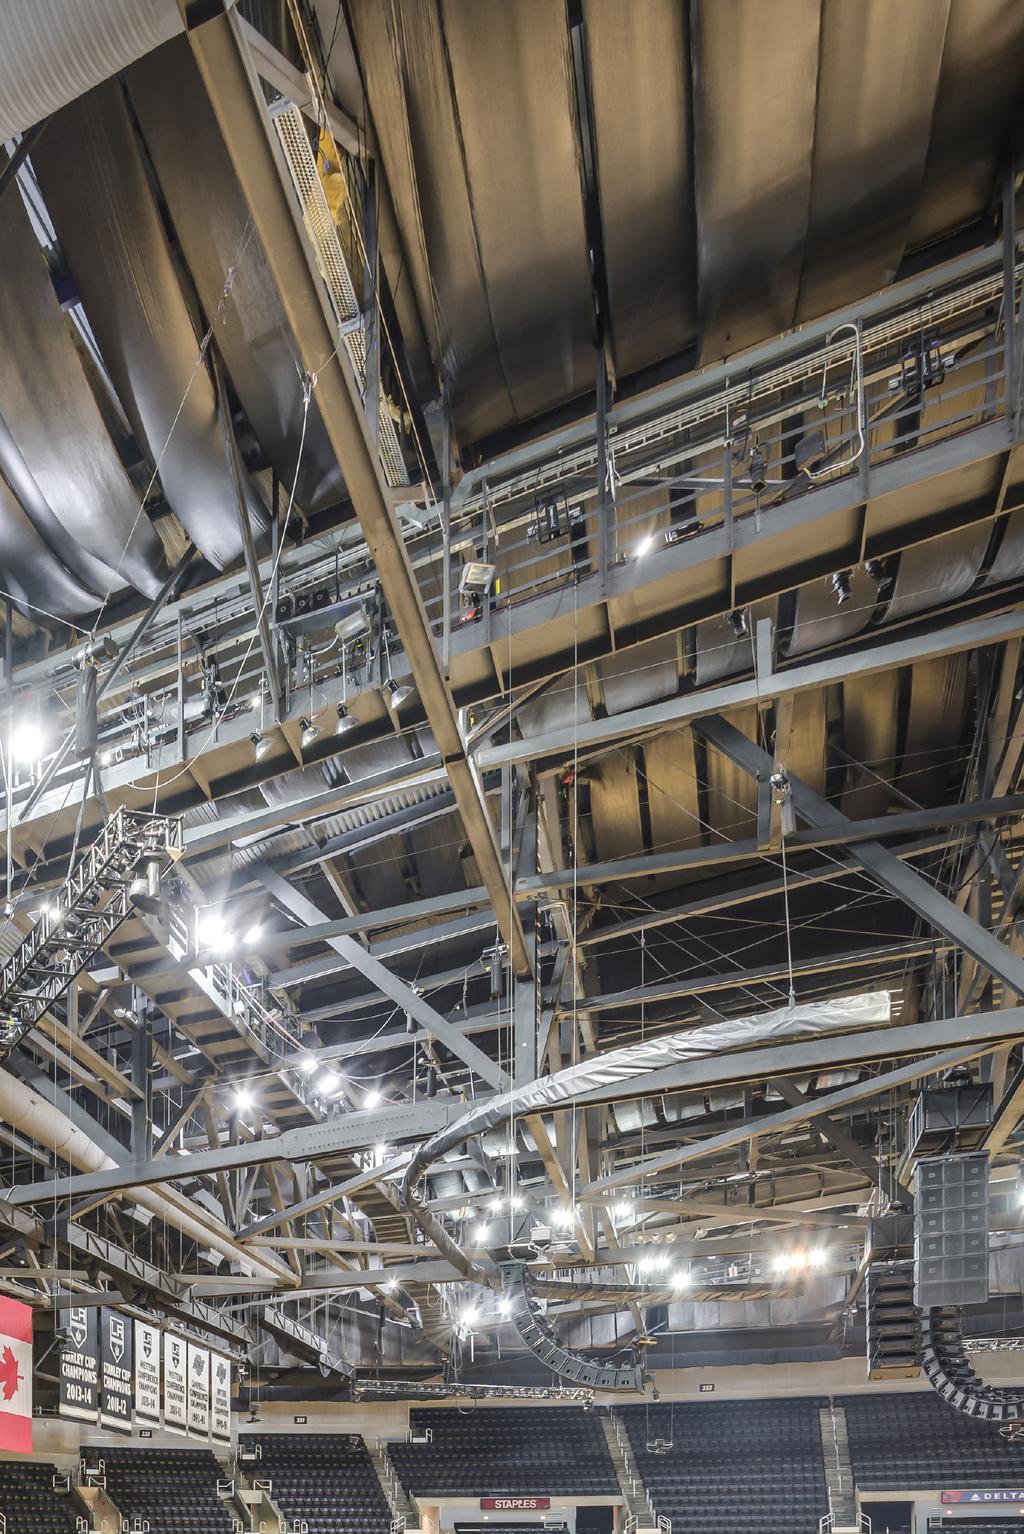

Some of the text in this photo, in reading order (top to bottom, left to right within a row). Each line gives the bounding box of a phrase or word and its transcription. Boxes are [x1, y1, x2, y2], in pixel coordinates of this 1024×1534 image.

[84, 1356, 96, 1370] CUP
[61, 1362, 97, 1385] CHAMPIONS
[66, 1383, 92, 1404] 2013-14
[107, 1395, 127, 1415] 2011-12
[495, 1500, 536, 1508] STAPLES
[984, 1492, 1024, 1500] DELTA
